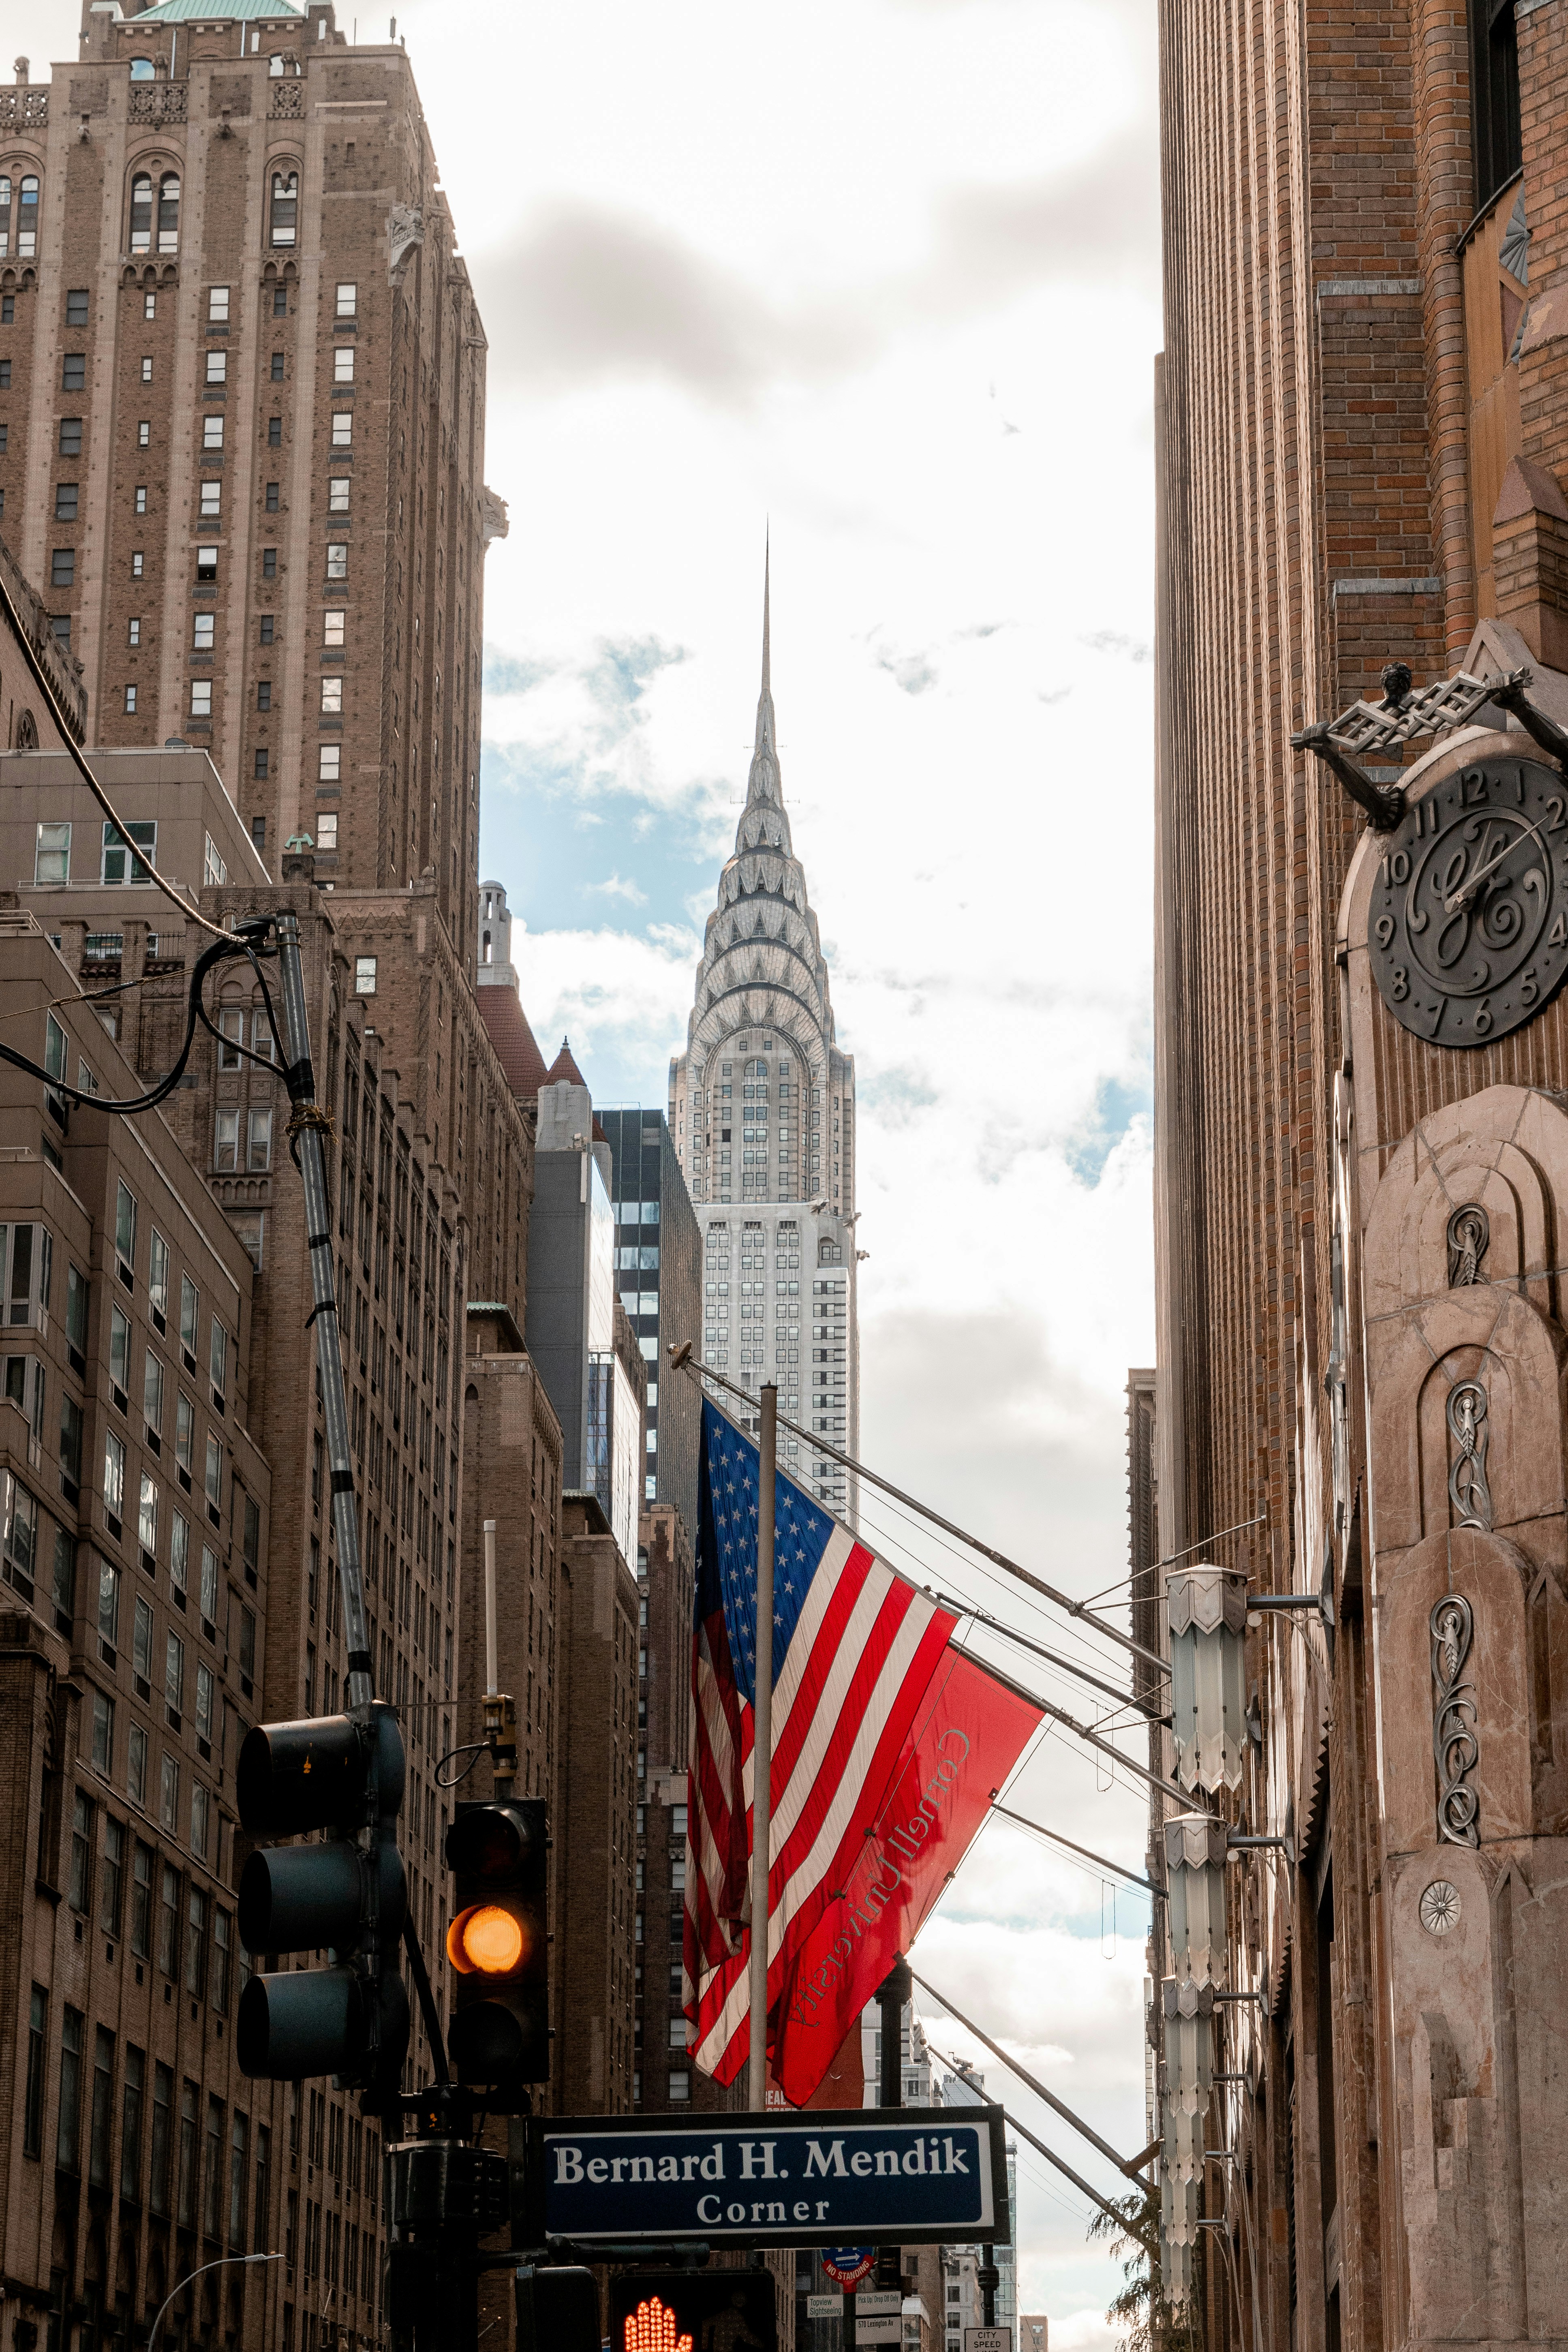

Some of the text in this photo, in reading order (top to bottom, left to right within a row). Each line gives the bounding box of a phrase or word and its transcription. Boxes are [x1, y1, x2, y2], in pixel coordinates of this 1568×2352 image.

[1460, 768, 1487, 808] 12
[1514, 768, 1525, 803] 1
[1414, 799, 1439, 838] 11
[1546, 796, 1567, 834] 2
[1383, 850, 1411, 889] 10
[1375, 914, 1395, 950] 9
[1548, 912, 1568, 948] 4
[1392, 966, 1408, 1001] 8
[1521, 968, 1539, 1006] 5
[1427, 997, 1448, 1037] 7
[1473, 997, 1493, 1035] 6
[554, 2136, 970, 2185] Bernard H. Mendik
[697, 2195, 830, 2224] Corner
[826, 2261, 870, 2280] NO STANDING
[810, 2298, 832, 2307] Topview
[810, 2307, 842, 2316] Sightseeing
[874, 2296, 883, 2304] Drop
[890, 2294, 898, 2303] Only
[867, 2320, 887, 2328] Lexington
